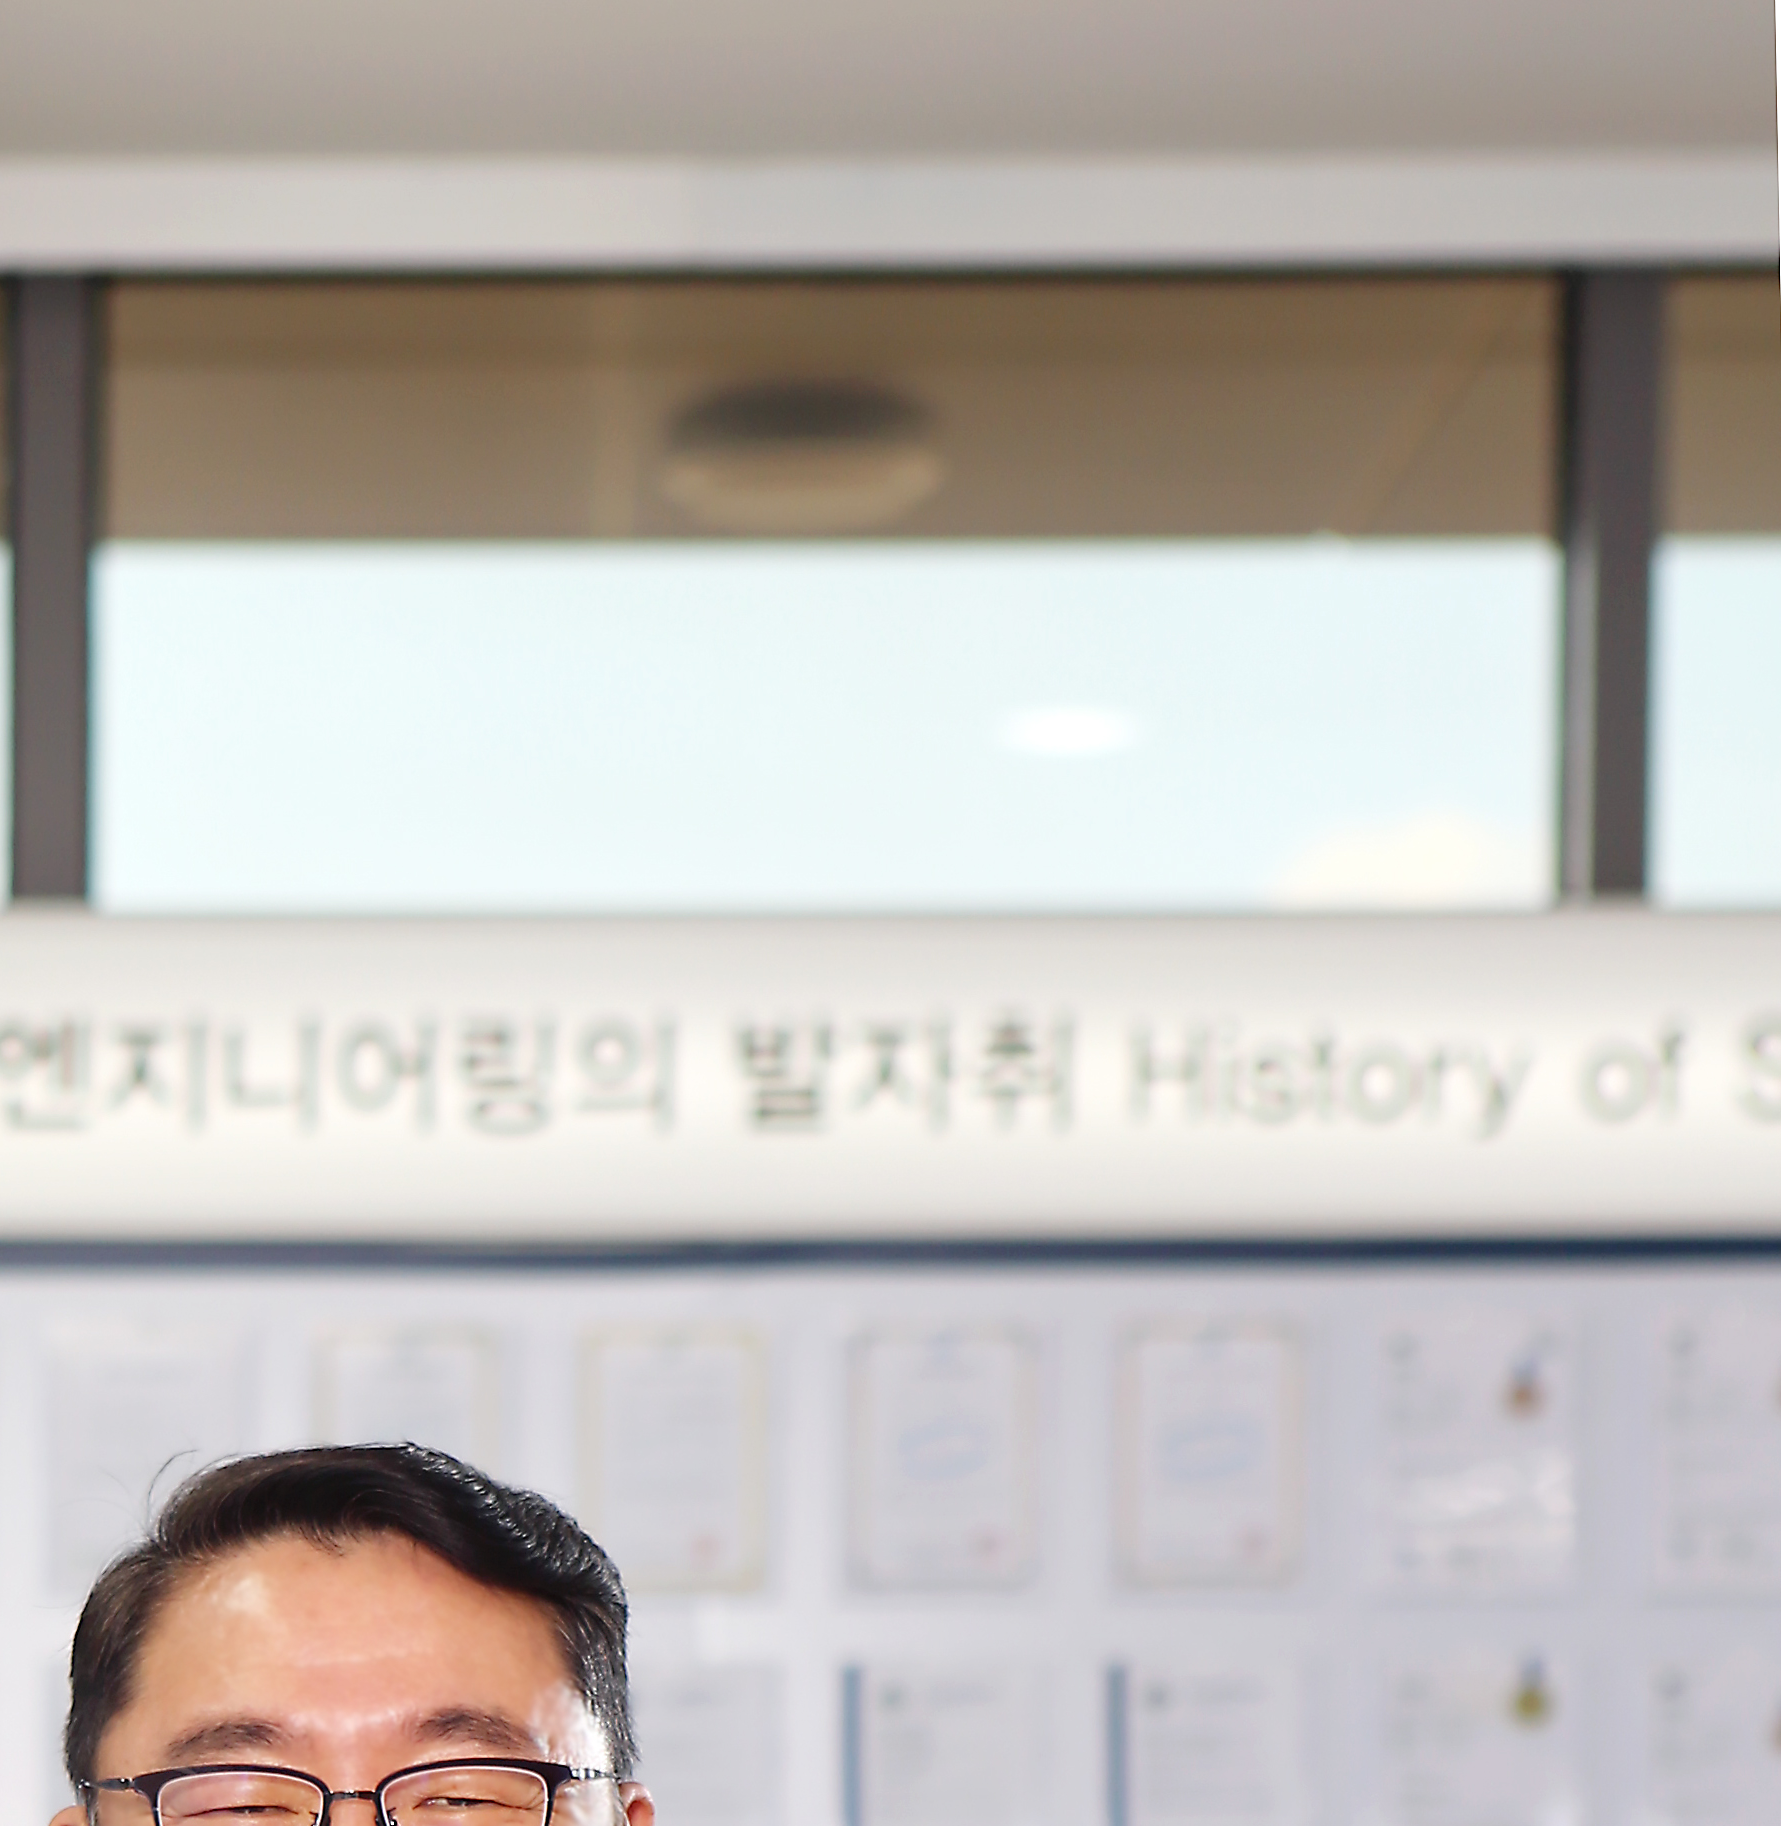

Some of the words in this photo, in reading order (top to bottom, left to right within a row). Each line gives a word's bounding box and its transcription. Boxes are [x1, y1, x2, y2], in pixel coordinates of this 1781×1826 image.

[732, 1014, 1077, 1134] 발자취
[1125, 1014, 1533, 1142] History
[1581, 1010, 1693, 1126] of
